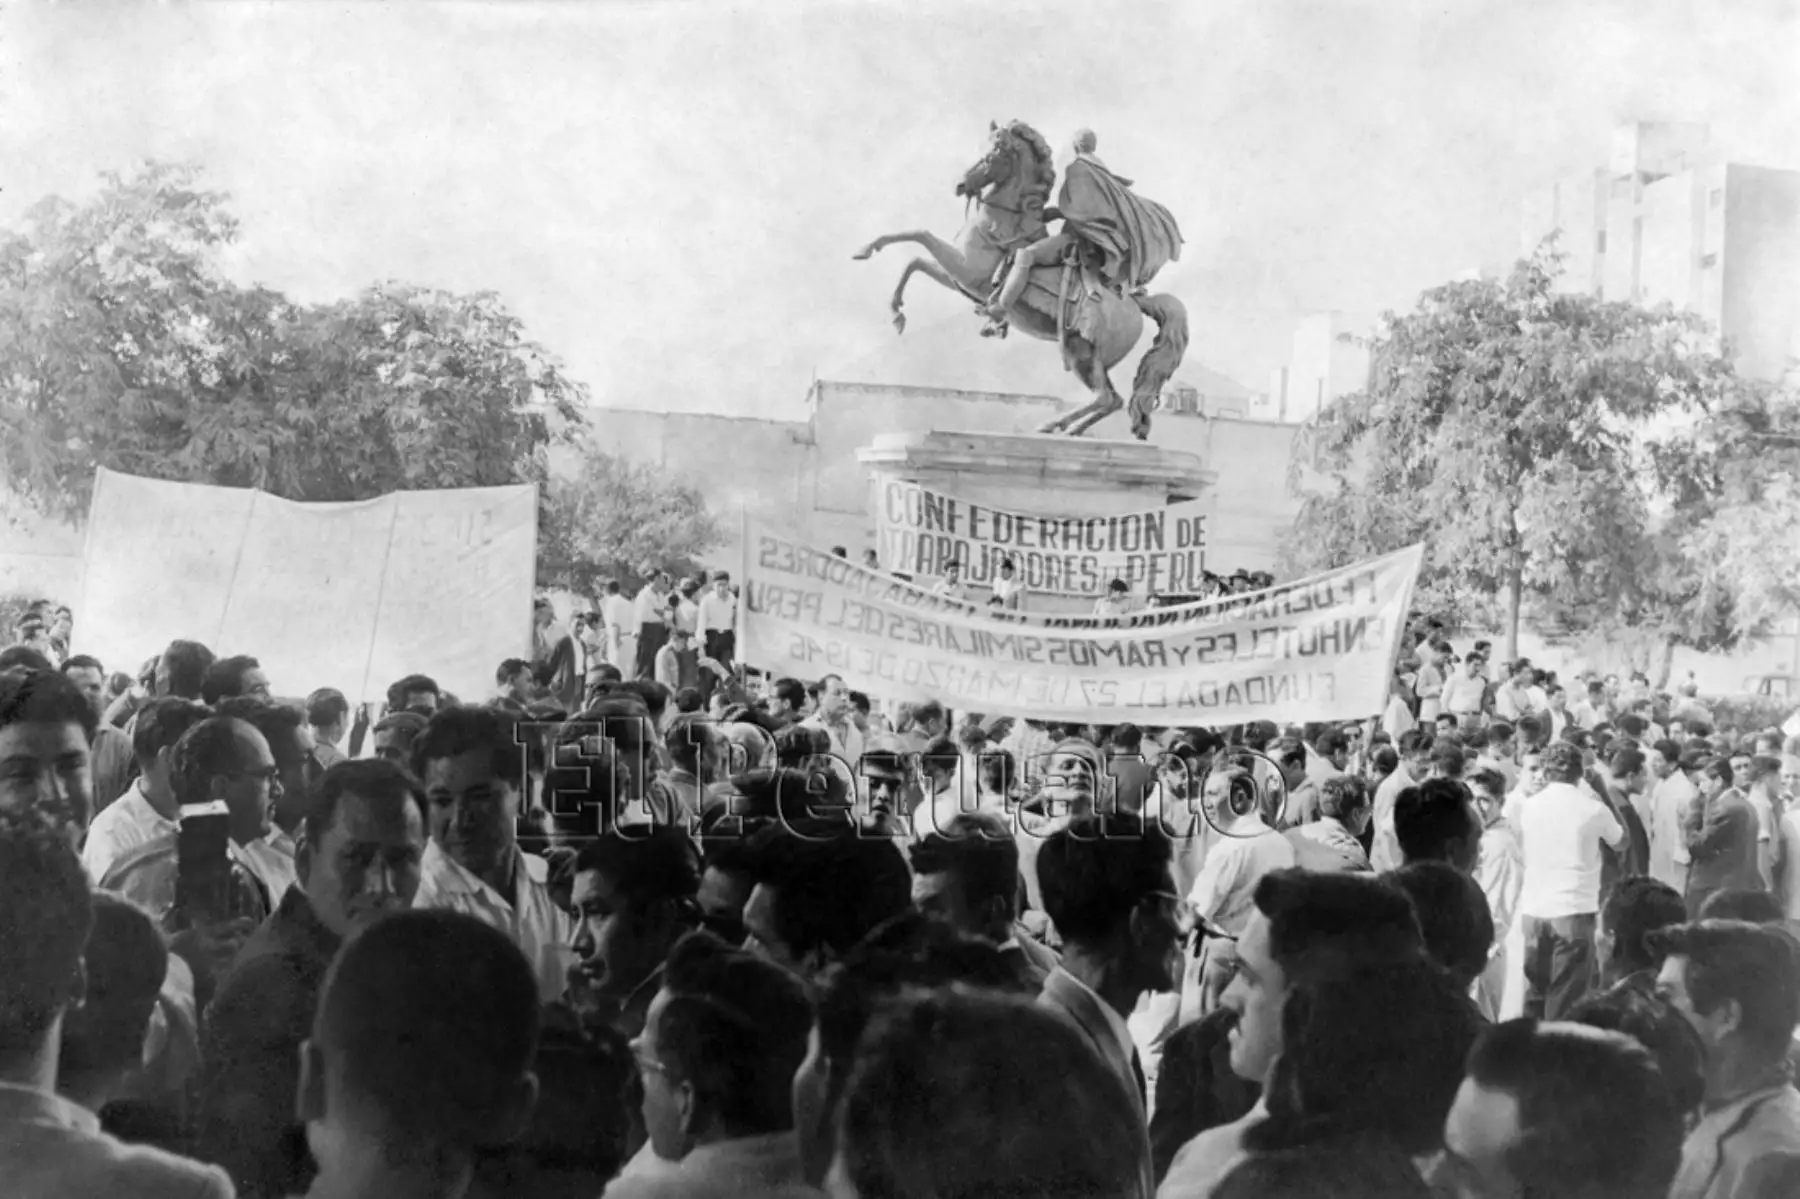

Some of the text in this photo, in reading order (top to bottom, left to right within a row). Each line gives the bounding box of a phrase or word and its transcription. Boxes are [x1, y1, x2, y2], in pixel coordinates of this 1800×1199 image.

[885, 482, 1206, 551] CONFEDERACION DE
[1126, 550, 1205, 594] PERU
